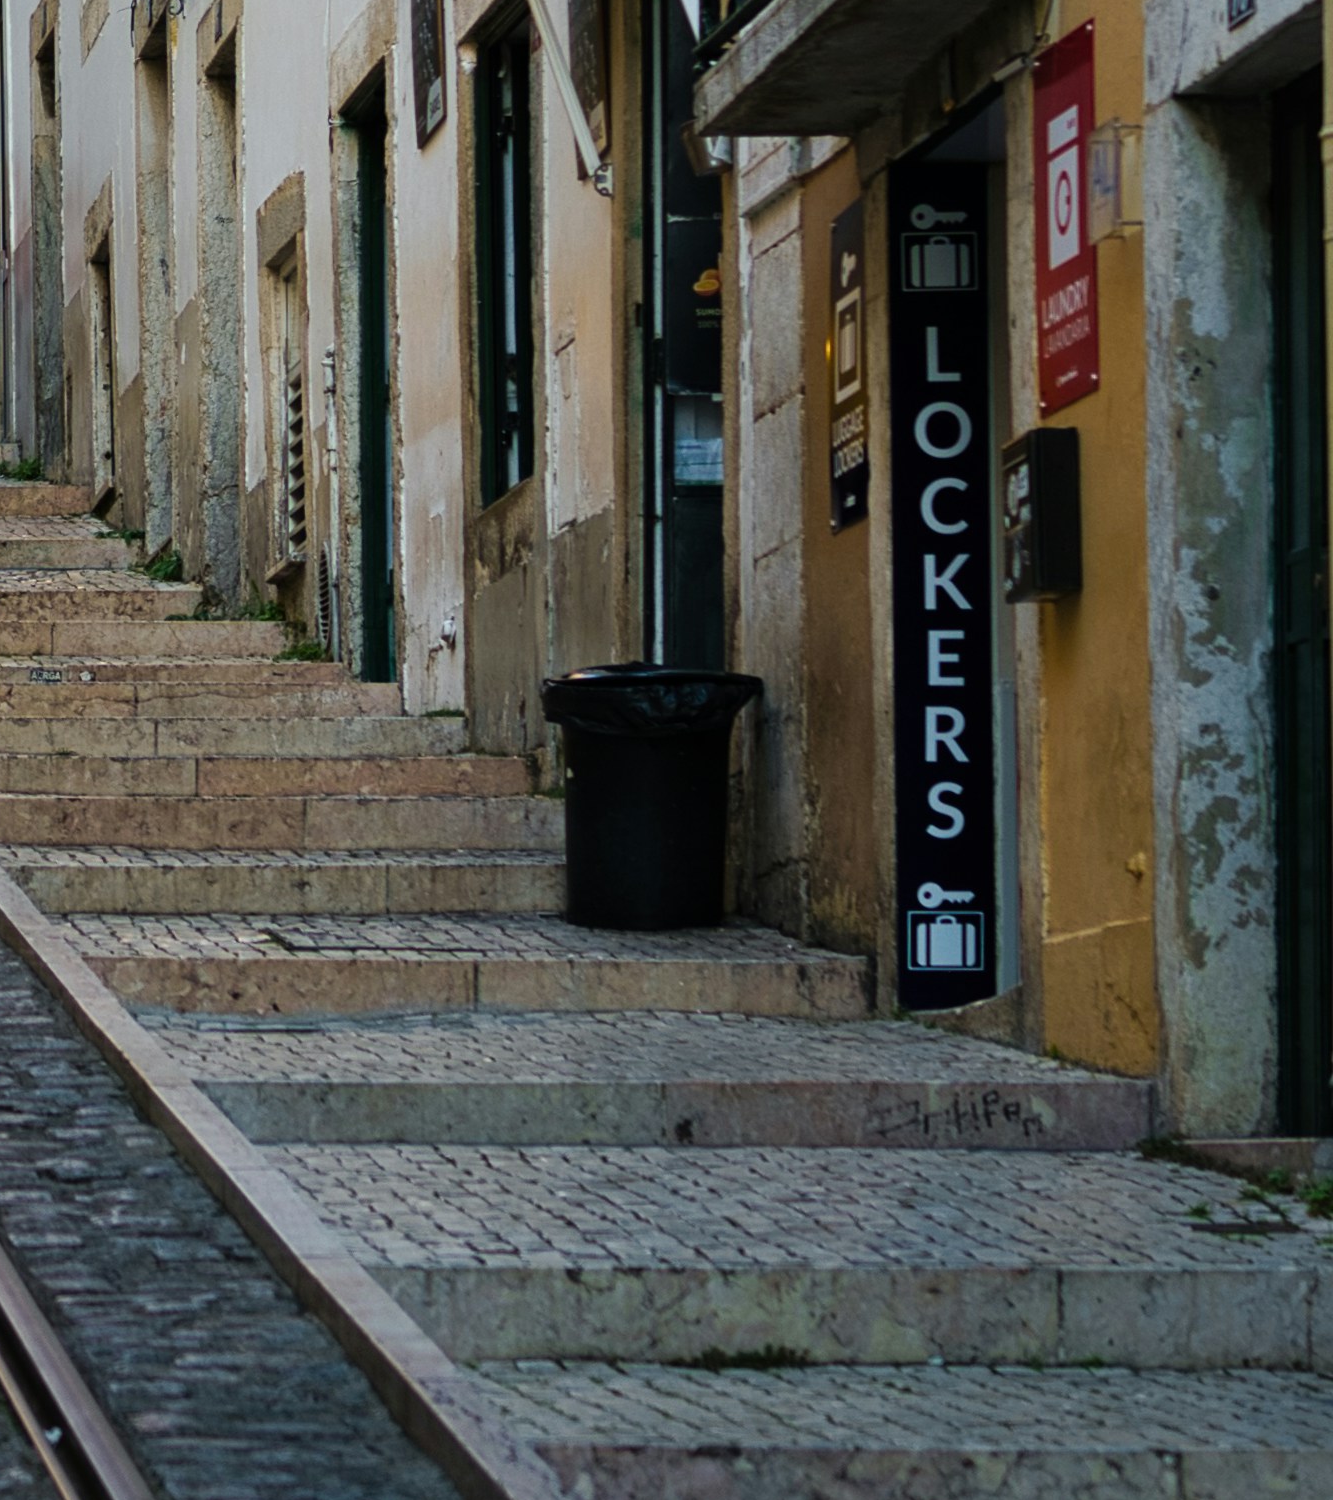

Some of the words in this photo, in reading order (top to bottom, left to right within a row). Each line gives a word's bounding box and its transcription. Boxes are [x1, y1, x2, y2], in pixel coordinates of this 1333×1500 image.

[1041, 275, 1089, 329] LAUNDRY
[832, 404, 865, 447] LUGGAGE
[833, 437, 865, 479] LOCKERS
[913, 325, 973, 840] LOCKERS
